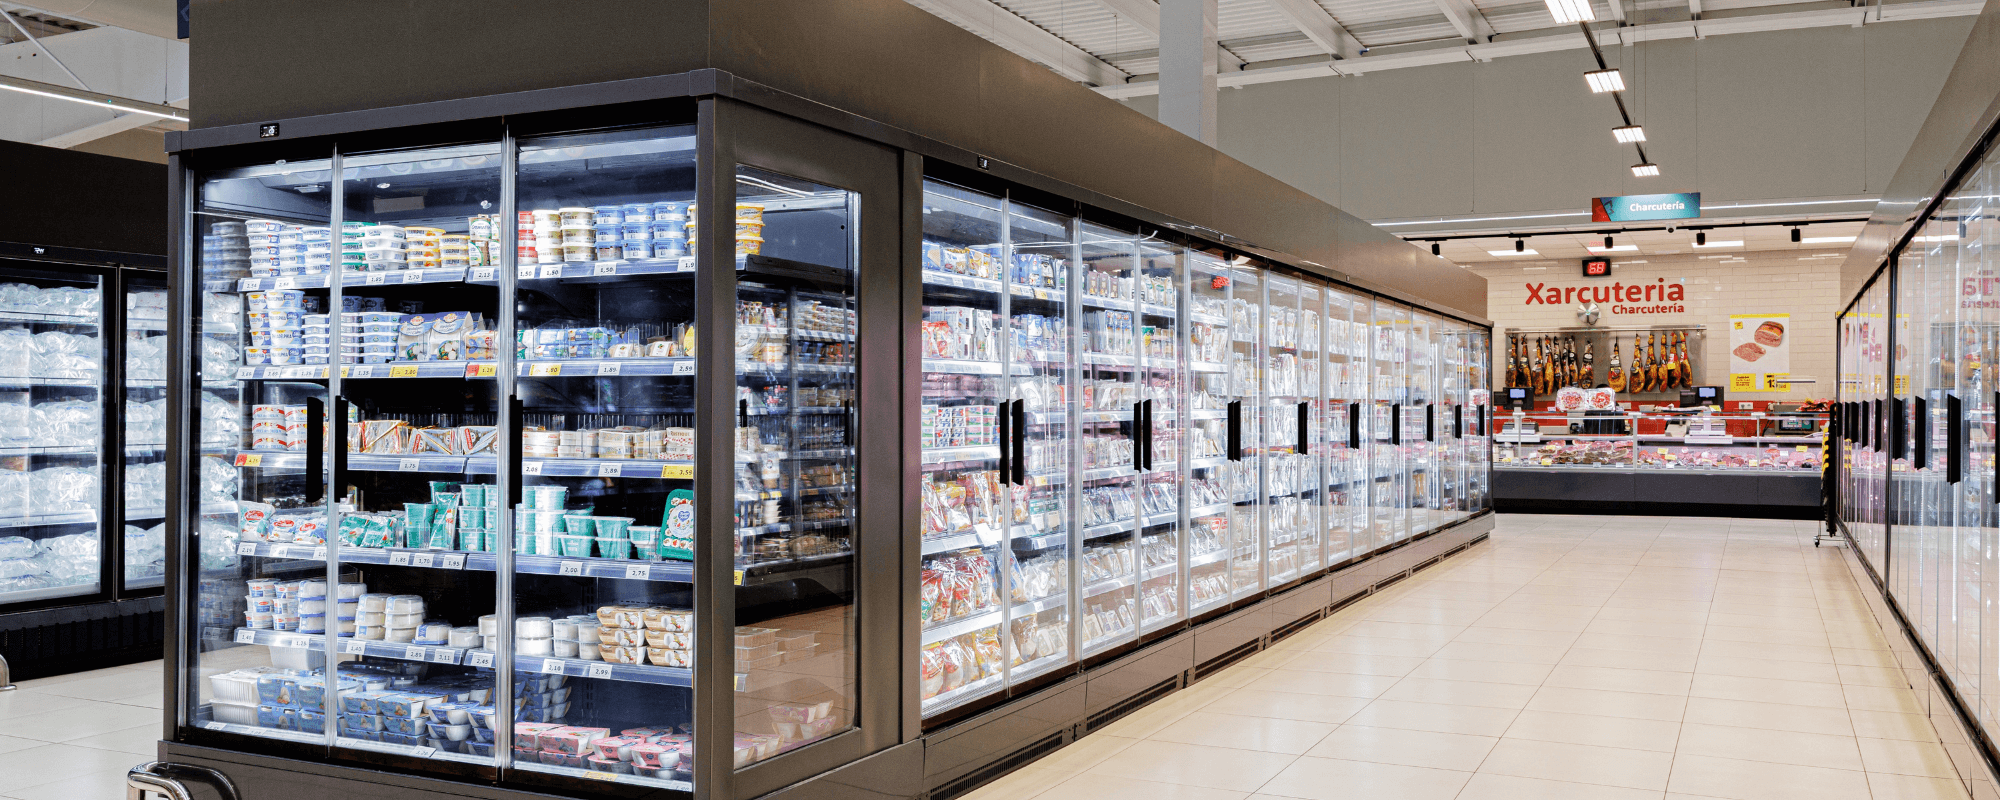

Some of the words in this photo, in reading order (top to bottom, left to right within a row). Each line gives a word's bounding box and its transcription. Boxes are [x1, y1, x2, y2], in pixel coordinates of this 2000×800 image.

[1629, 201, 1685, 212] Charcutería
[1525, 277, 1685, 305] Xarcuteria
[1612, 303, 1685, 315] Charcutería
